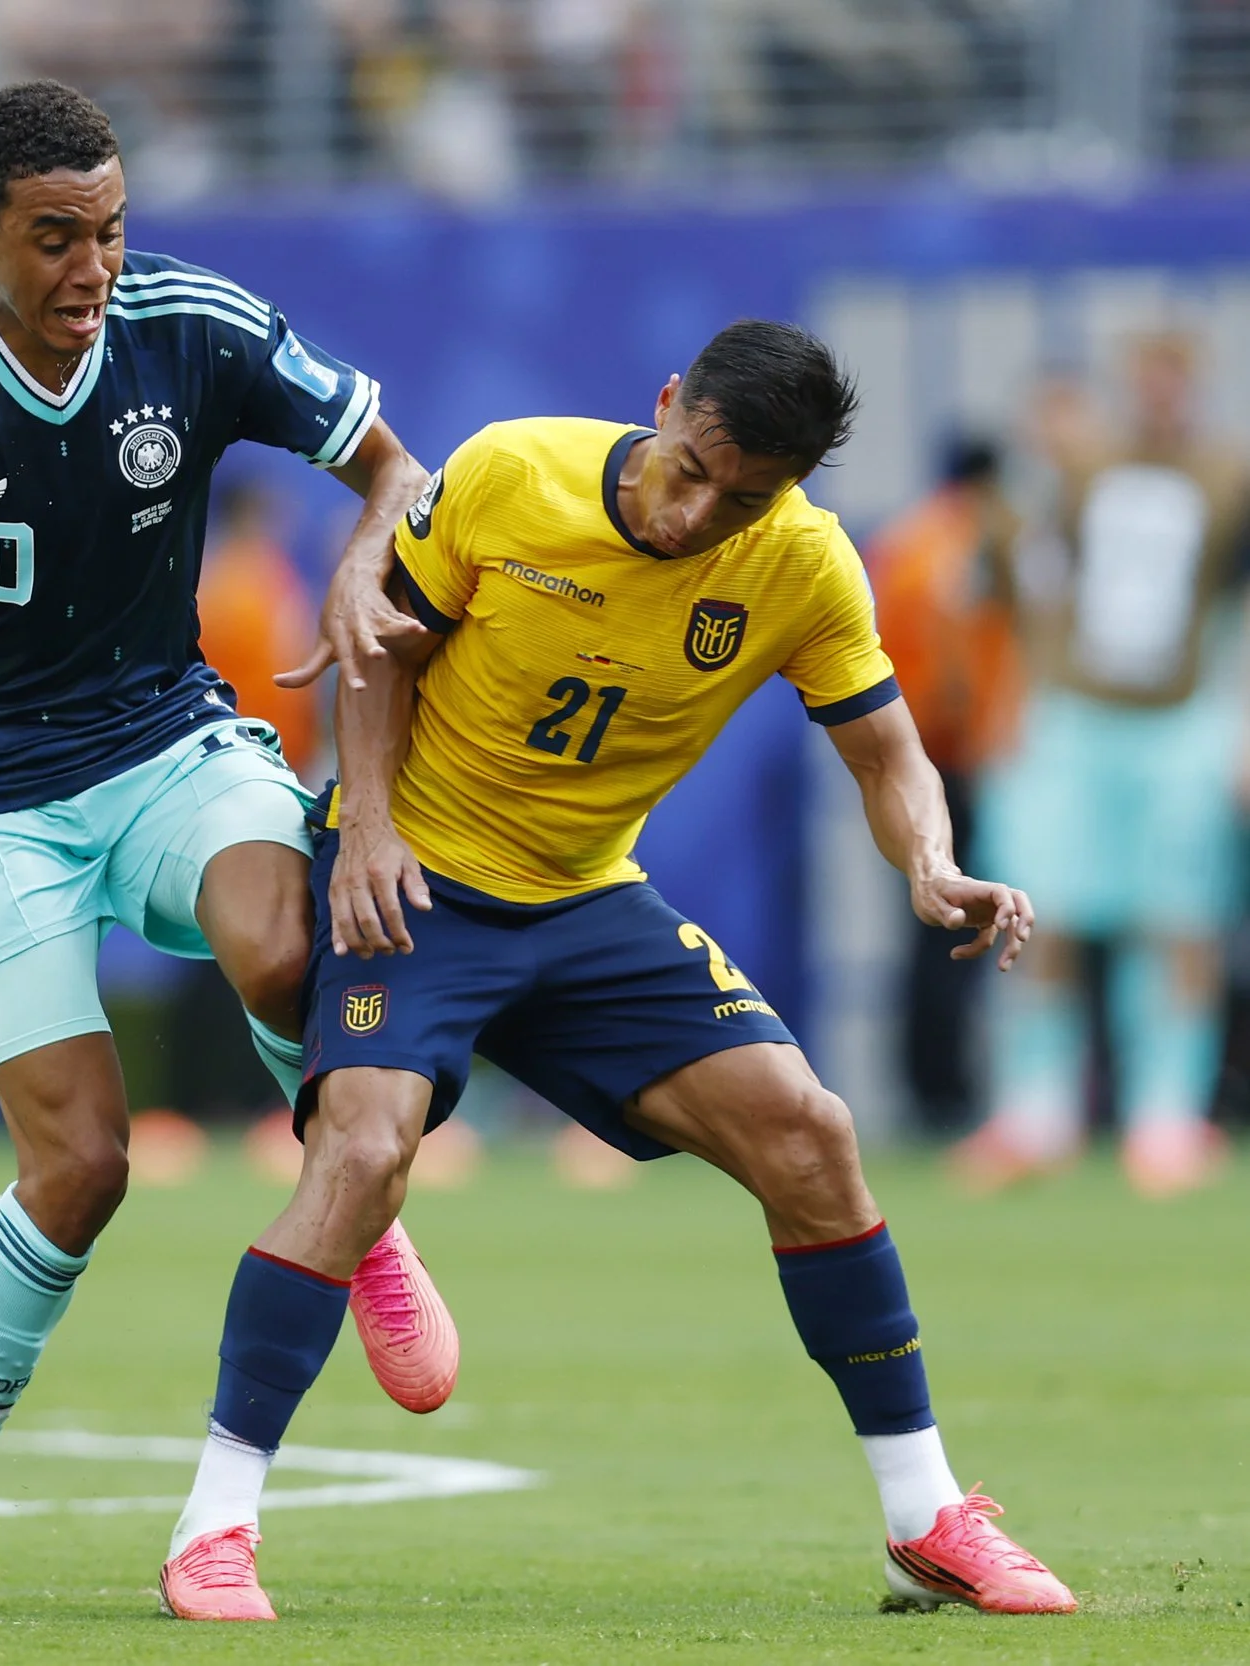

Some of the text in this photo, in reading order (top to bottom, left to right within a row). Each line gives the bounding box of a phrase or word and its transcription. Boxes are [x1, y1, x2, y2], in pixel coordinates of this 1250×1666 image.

[130, 432, 165, 450] DEUTSCHER
[132, 456, 173, 480] FUSSBALL-BUND
[502, 560, 606, 607] marathon
[526, 676, 628, 764] 21
